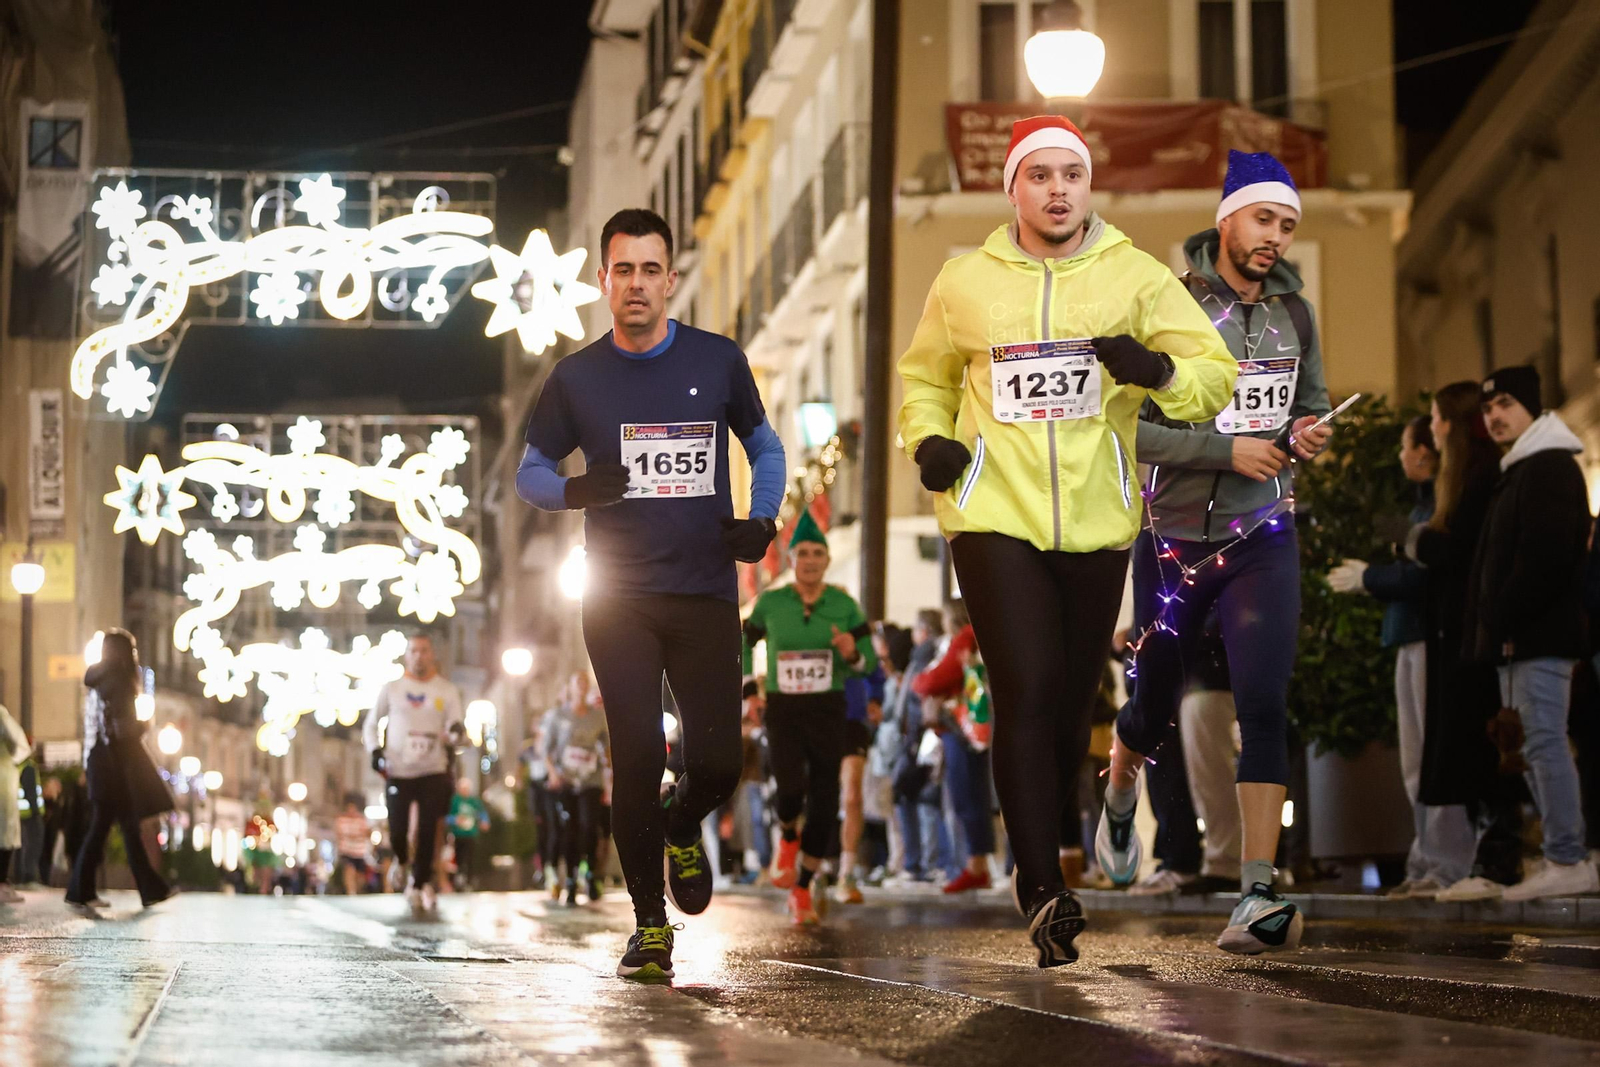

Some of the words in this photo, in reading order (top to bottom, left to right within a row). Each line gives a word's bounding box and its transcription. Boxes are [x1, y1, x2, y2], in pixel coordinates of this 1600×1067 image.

[994, 348, 1006, 362] 33
[1004, 351, 1040, 361] NOCTURNA
[1005, 344, 1039, 355] CARRERA
[1007, 370, 1090, 400] 1237
[1233, 385, 1289, 411] 1519
[624, 427, 636, 440] 33
[635, 432, 669, 440] NOCTURNA
[635, 451, 708, 476] 1655
[785, 666, 827, 680] 1842
